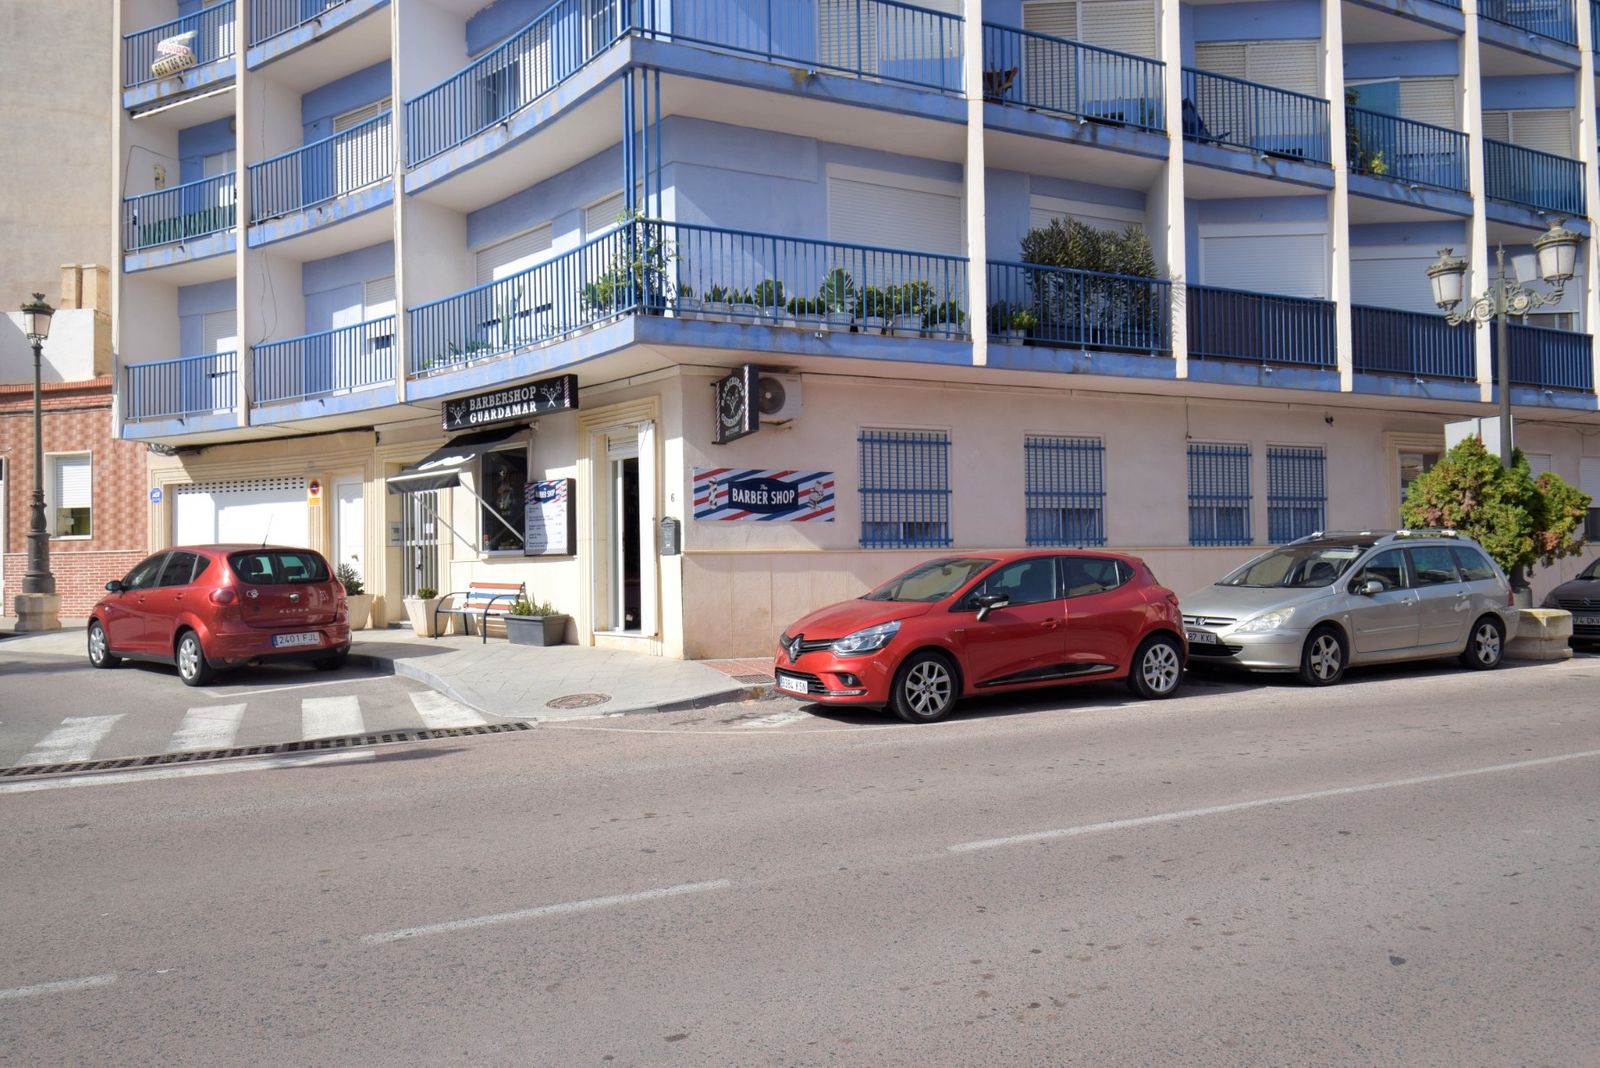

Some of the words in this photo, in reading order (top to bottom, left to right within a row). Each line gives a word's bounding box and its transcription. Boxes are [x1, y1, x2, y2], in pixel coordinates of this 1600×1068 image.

[469, 385, 537, 411] BARBERSHOP
[469, 400, 537, 423] GUARDAMAR
[732, 488, 769, 505] BARBER
[770, 489, 796, 505] SHOP
[279, 634, 301, 645] 2401
